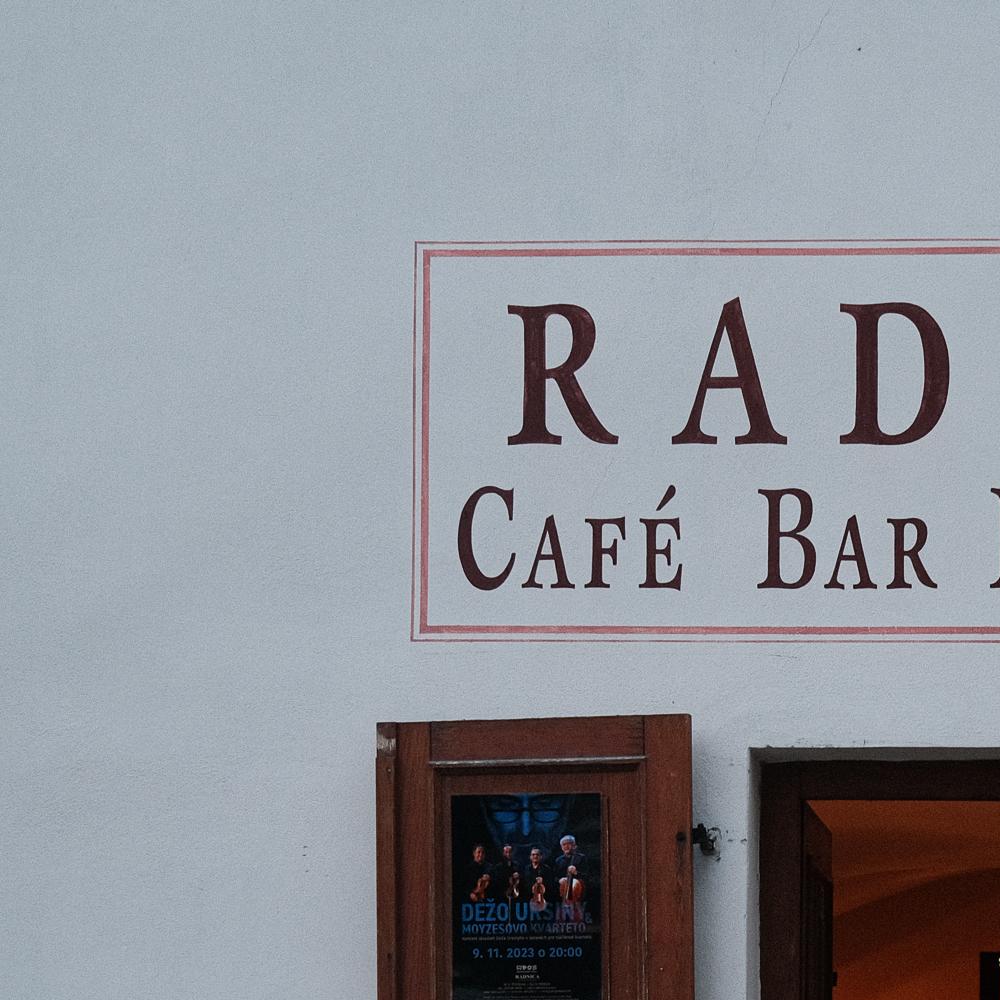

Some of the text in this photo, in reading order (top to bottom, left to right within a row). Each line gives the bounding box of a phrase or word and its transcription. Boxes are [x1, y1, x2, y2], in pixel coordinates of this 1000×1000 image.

[462, 898, 509, 922] DEŽO
[462, 922, 586, 935] MOYZESOVO KVARTETO
[472, 948, 484, 959] 9.
[488, 948, 503, 959] 11.
[507, 948, 535, 958] 2023
[549, 946, 583, 958] 20:00
